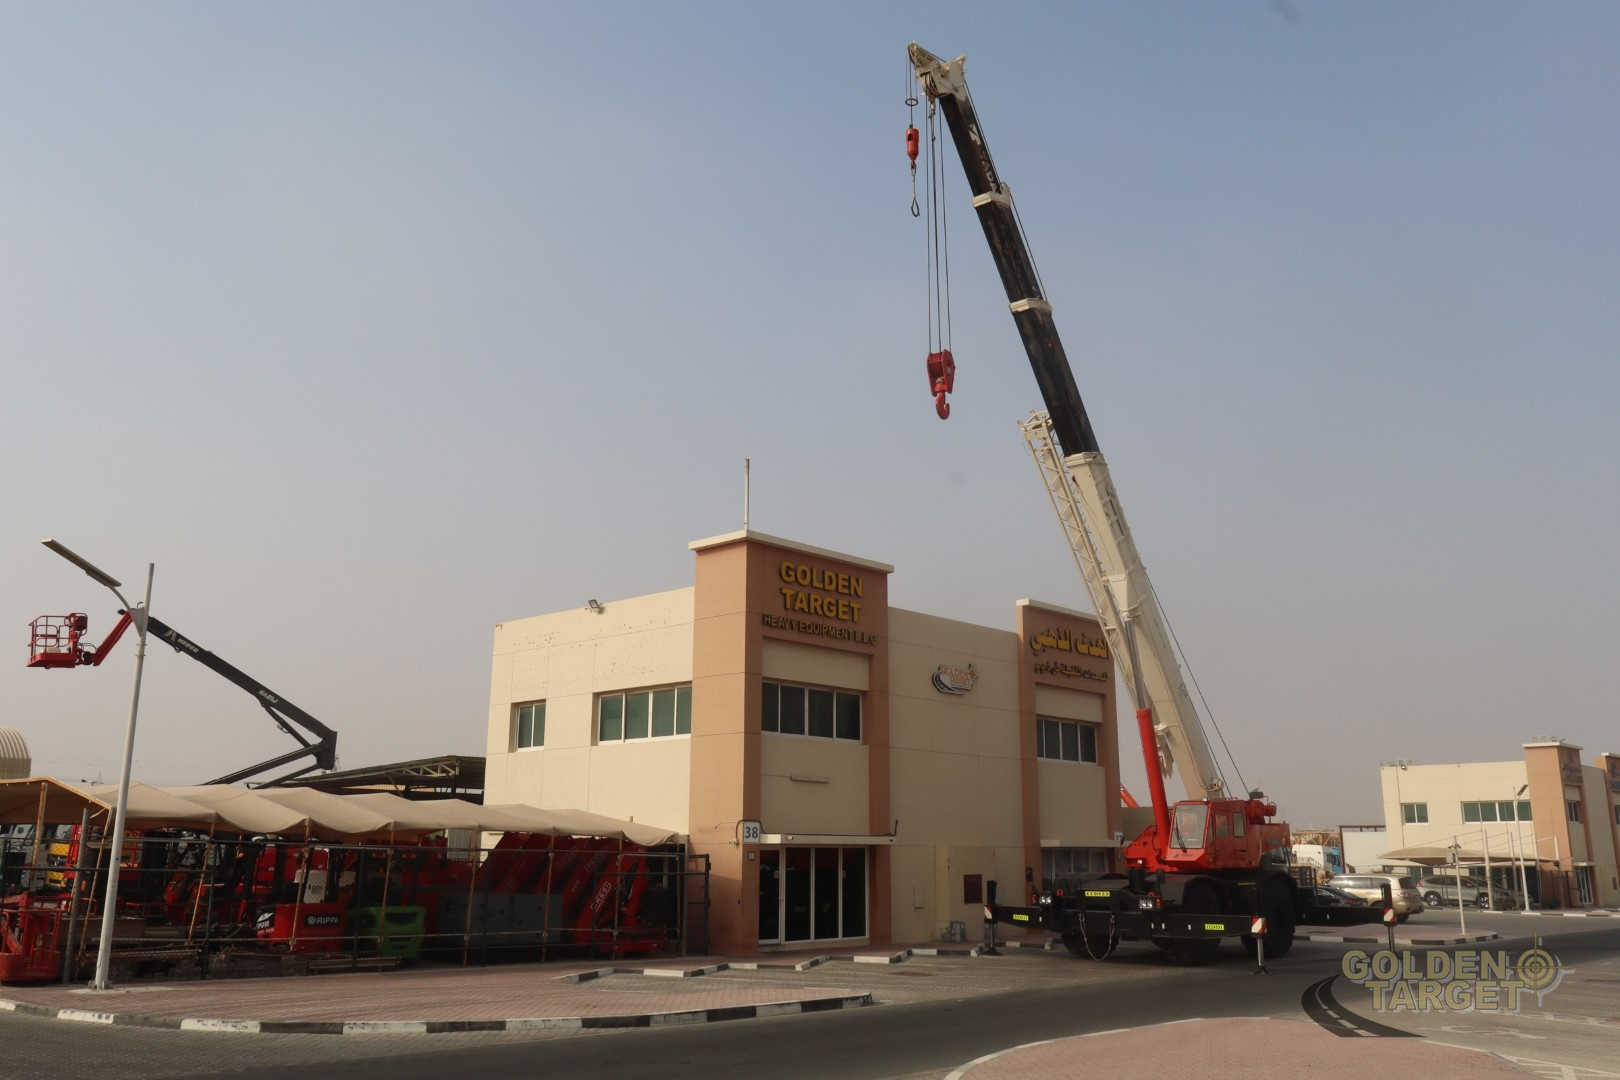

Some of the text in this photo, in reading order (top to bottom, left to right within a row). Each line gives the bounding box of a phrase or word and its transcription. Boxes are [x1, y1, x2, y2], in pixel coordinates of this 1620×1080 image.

[779, 561, 863, 597] GOLDEN
[780, 587, 862, 622] TARGET
[762, 613, 799, 631] HEAVY
[799, 621, 852, 640] EQUIPMENT
[745, 826, 758, 839] 38
[316, 916, 339, 925] RIPPA
